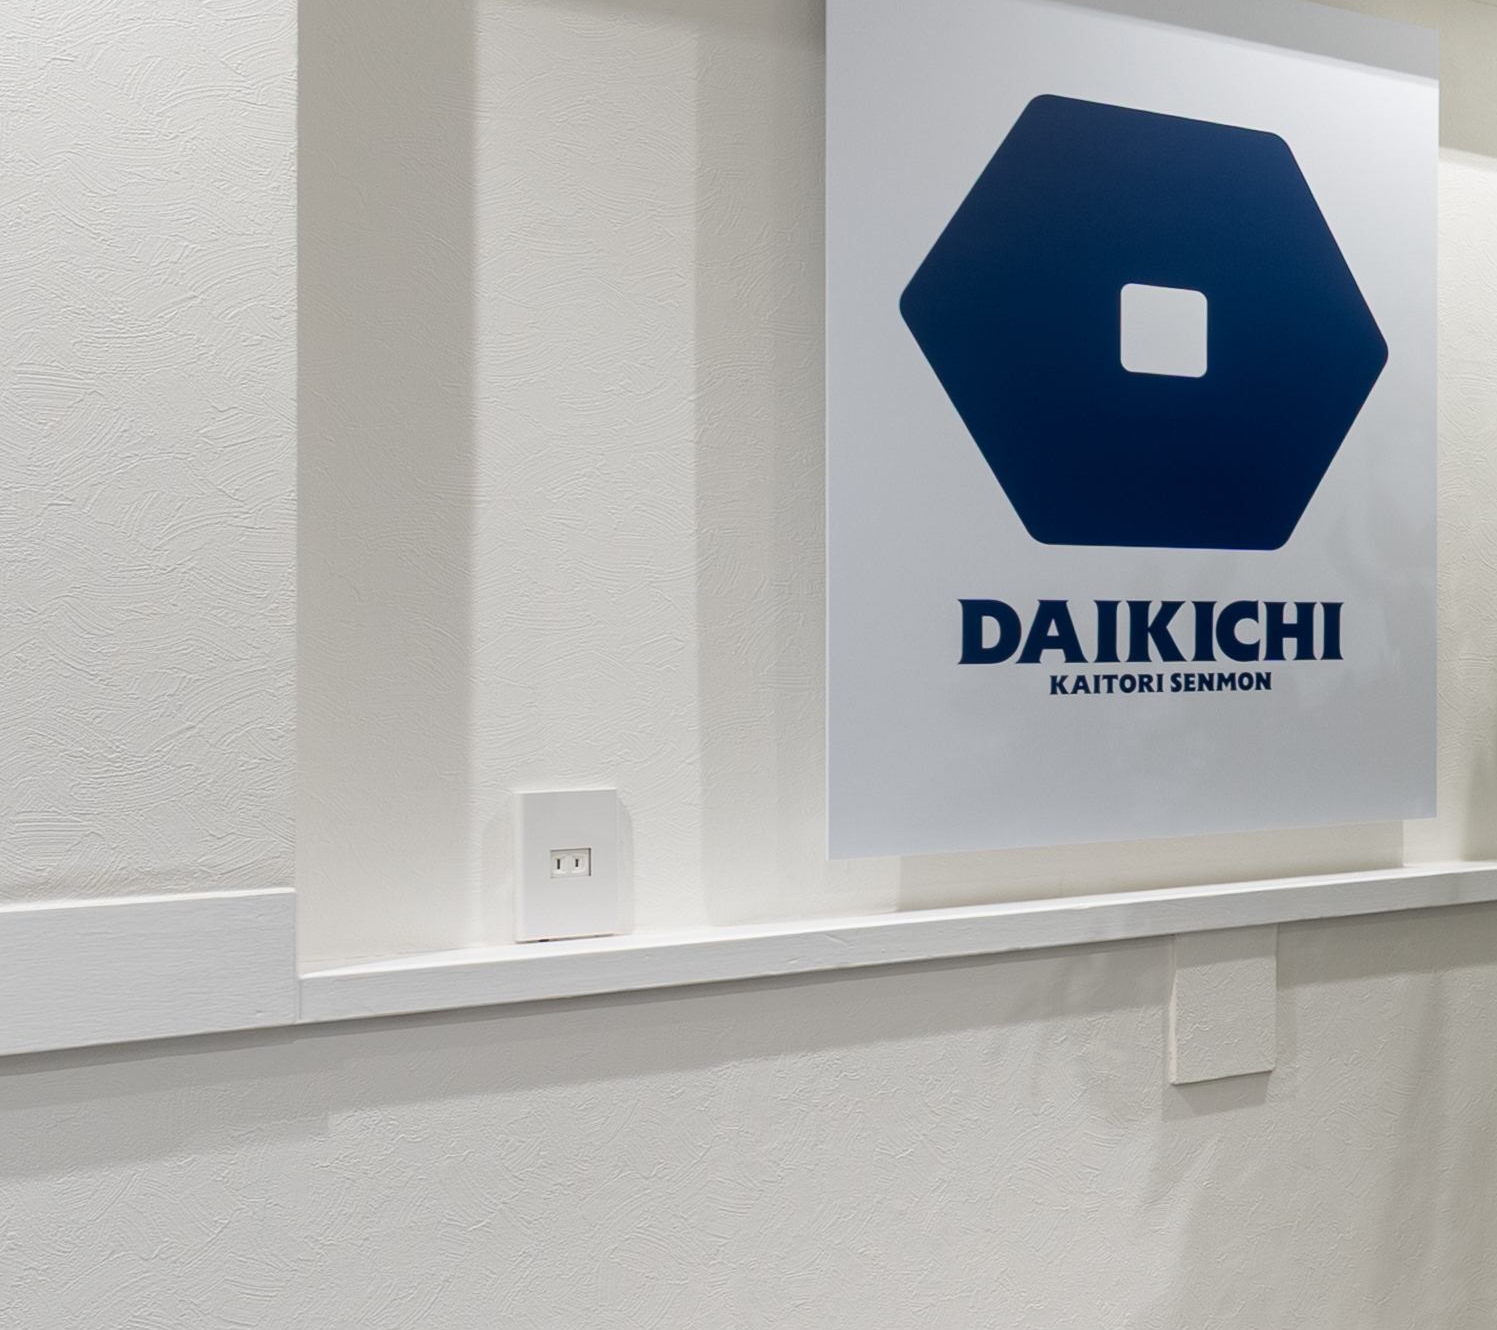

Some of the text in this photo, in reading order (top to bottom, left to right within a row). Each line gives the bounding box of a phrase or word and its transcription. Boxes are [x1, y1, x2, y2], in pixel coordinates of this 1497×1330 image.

[956, 598, 1344, 666] DAIKICHI
[1049, 671, 1272, 696] KAITORI SENMON
